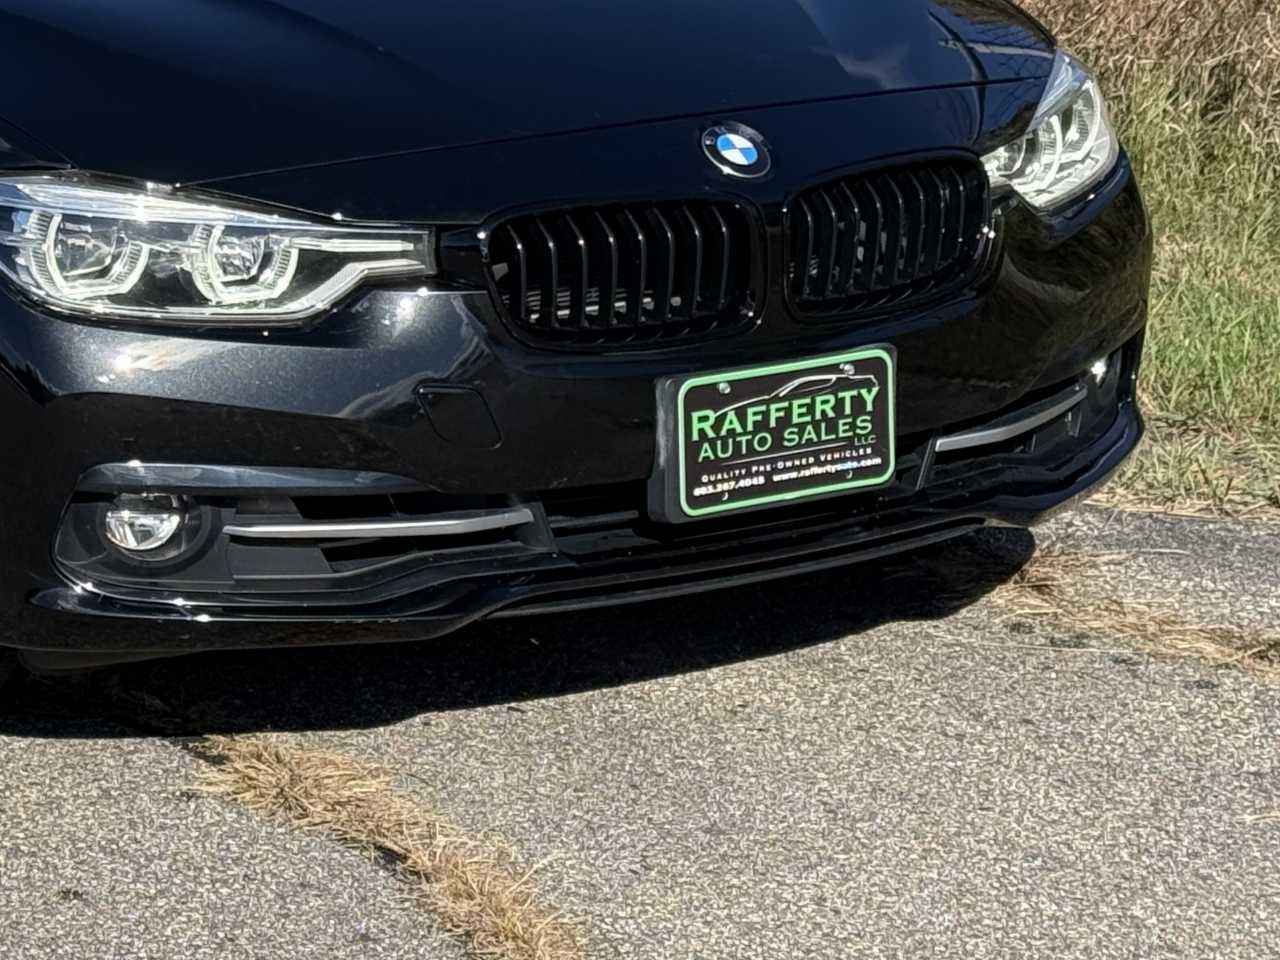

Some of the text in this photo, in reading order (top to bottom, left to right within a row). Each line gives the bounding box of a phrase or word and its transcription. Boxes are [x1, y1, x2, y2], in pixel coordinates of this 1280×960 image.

[691, 386, 881, 442] RAFFERTY
[699, 415, 873, 464] AUTO SALES
[854, 434, 877, 447] LLC
[701, 468, 747, 483] QUALITY
[820, 447, 873, 462] VEHICLES
